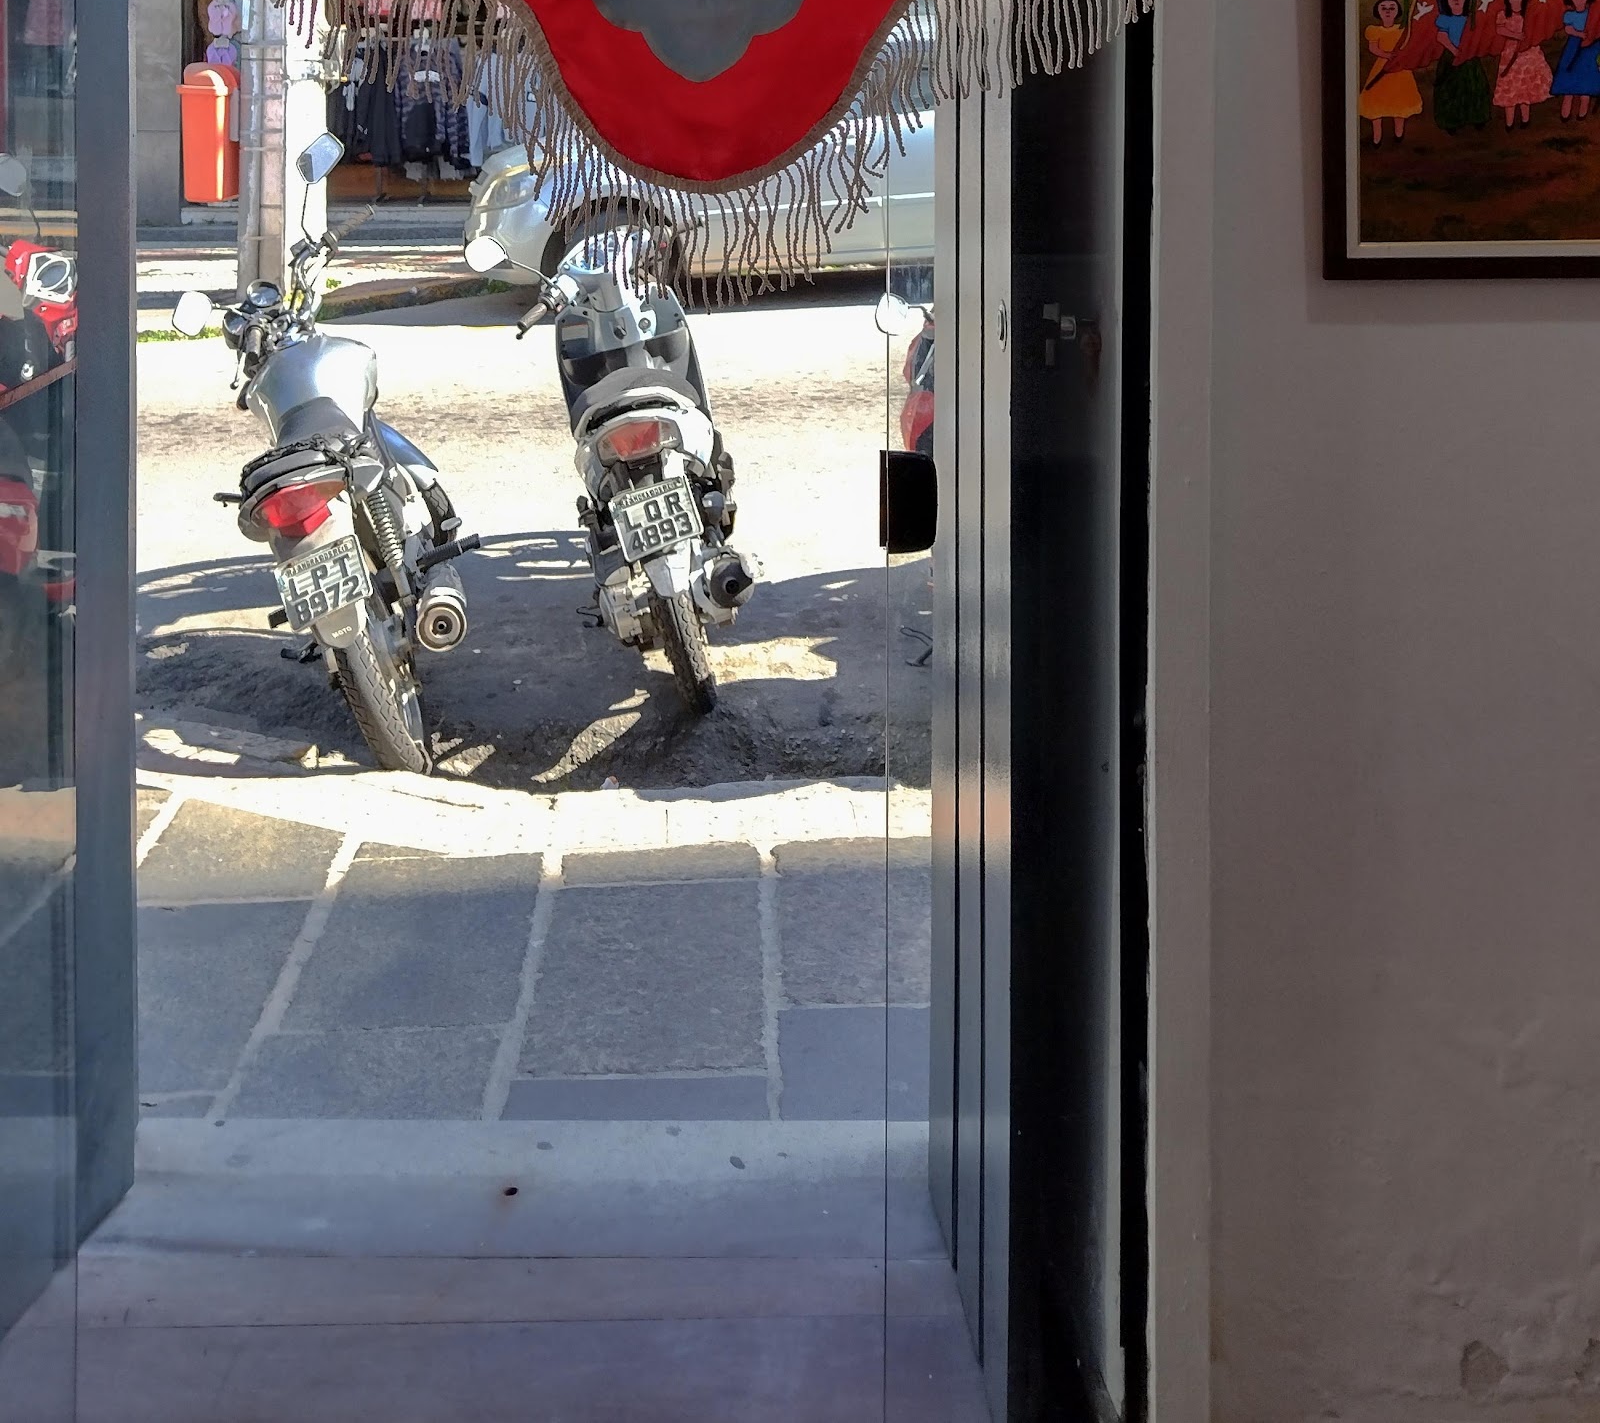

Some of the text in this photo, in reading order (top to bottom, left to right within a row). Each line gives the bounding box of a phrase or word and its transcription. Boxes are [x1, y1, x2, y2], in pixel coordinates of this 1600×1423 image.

[621, 491, 686, 534] LQR
[632, 511, 694, 553] 4893
[287, 553, 352, 603] LPT
[294, 575, 364, 627] 8972
